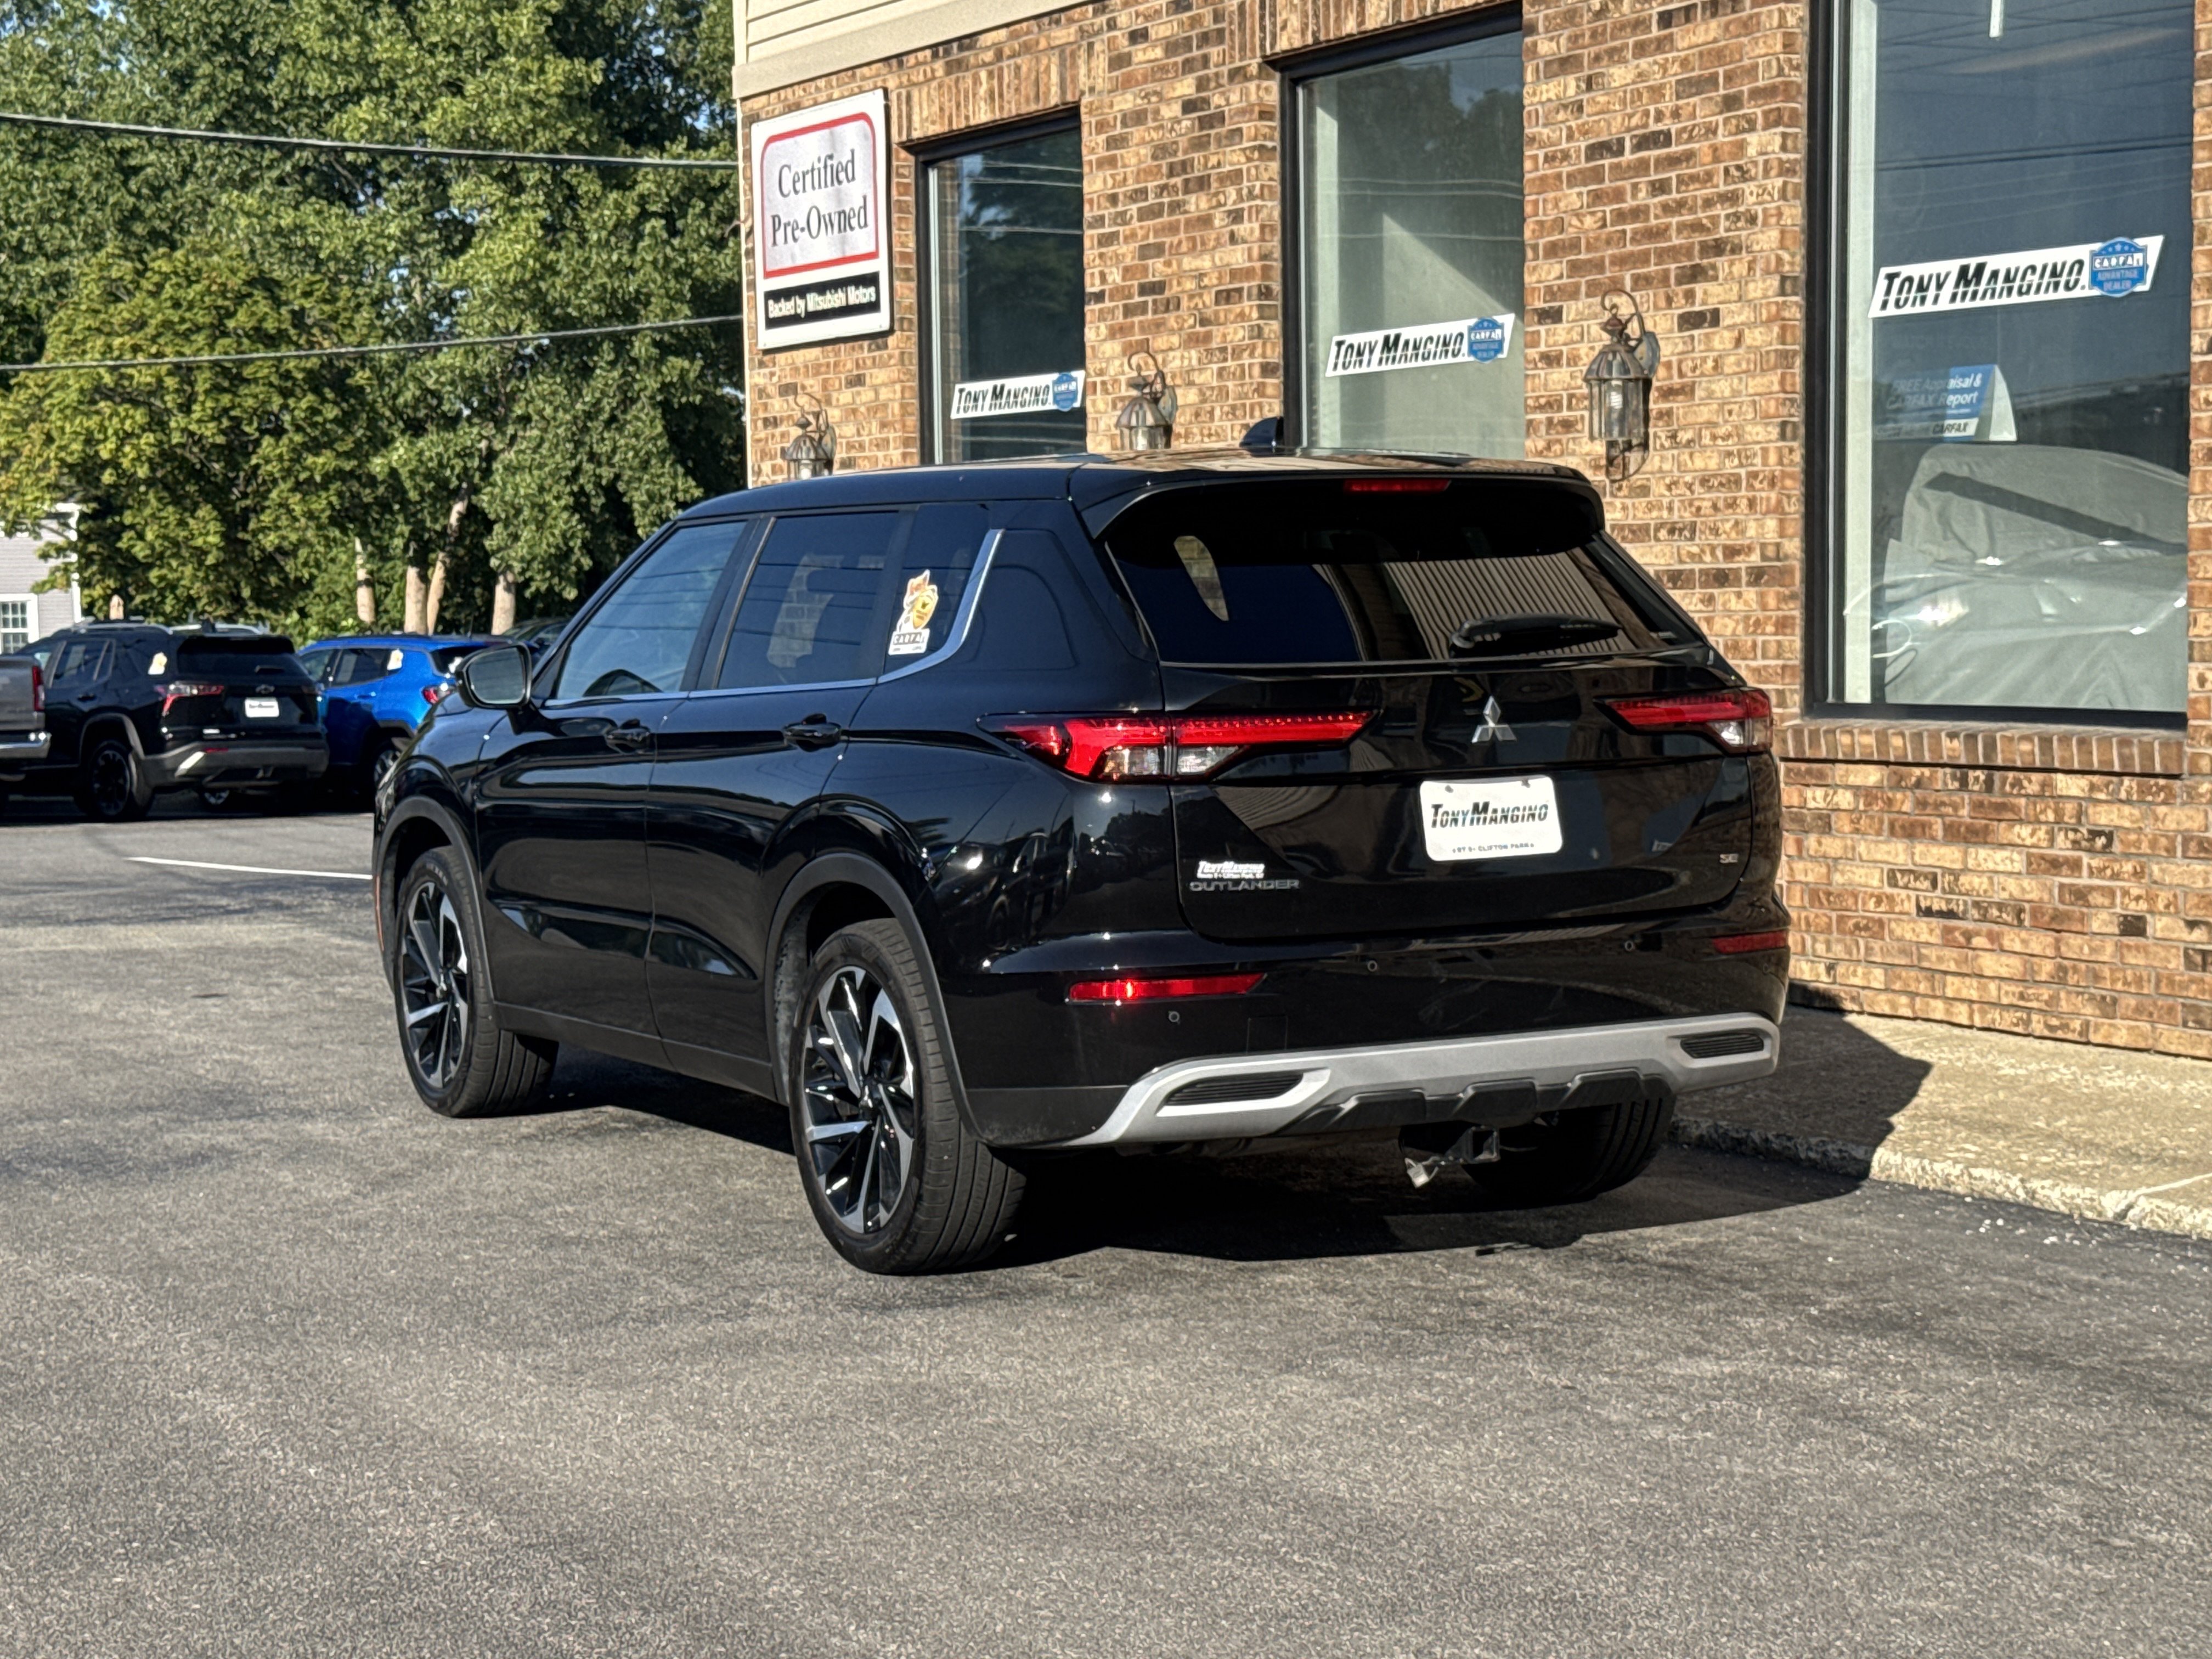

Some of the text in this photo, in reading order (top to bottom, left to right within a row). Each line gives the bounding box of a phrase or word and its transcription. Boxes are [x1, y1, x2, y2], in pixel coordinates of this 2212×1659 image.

[778, 148, 856, 198] Certified
[771, 195, 868, 247] Pre-Owned
[768, 285, 876, 319] Backed by Mitsubishi Motors
[1878, 270, 1951, 311] TONY
[1331, 339, 1379, 371] TONY
[1973, 372, 1983, 387] &
[956, 387, 989, 414] TONY
[1937, 390, 1978, 408] Report
[1932, 422, 1969, 435] CARFAX
[1189, 879, 1300, 891] OUTLANDER
